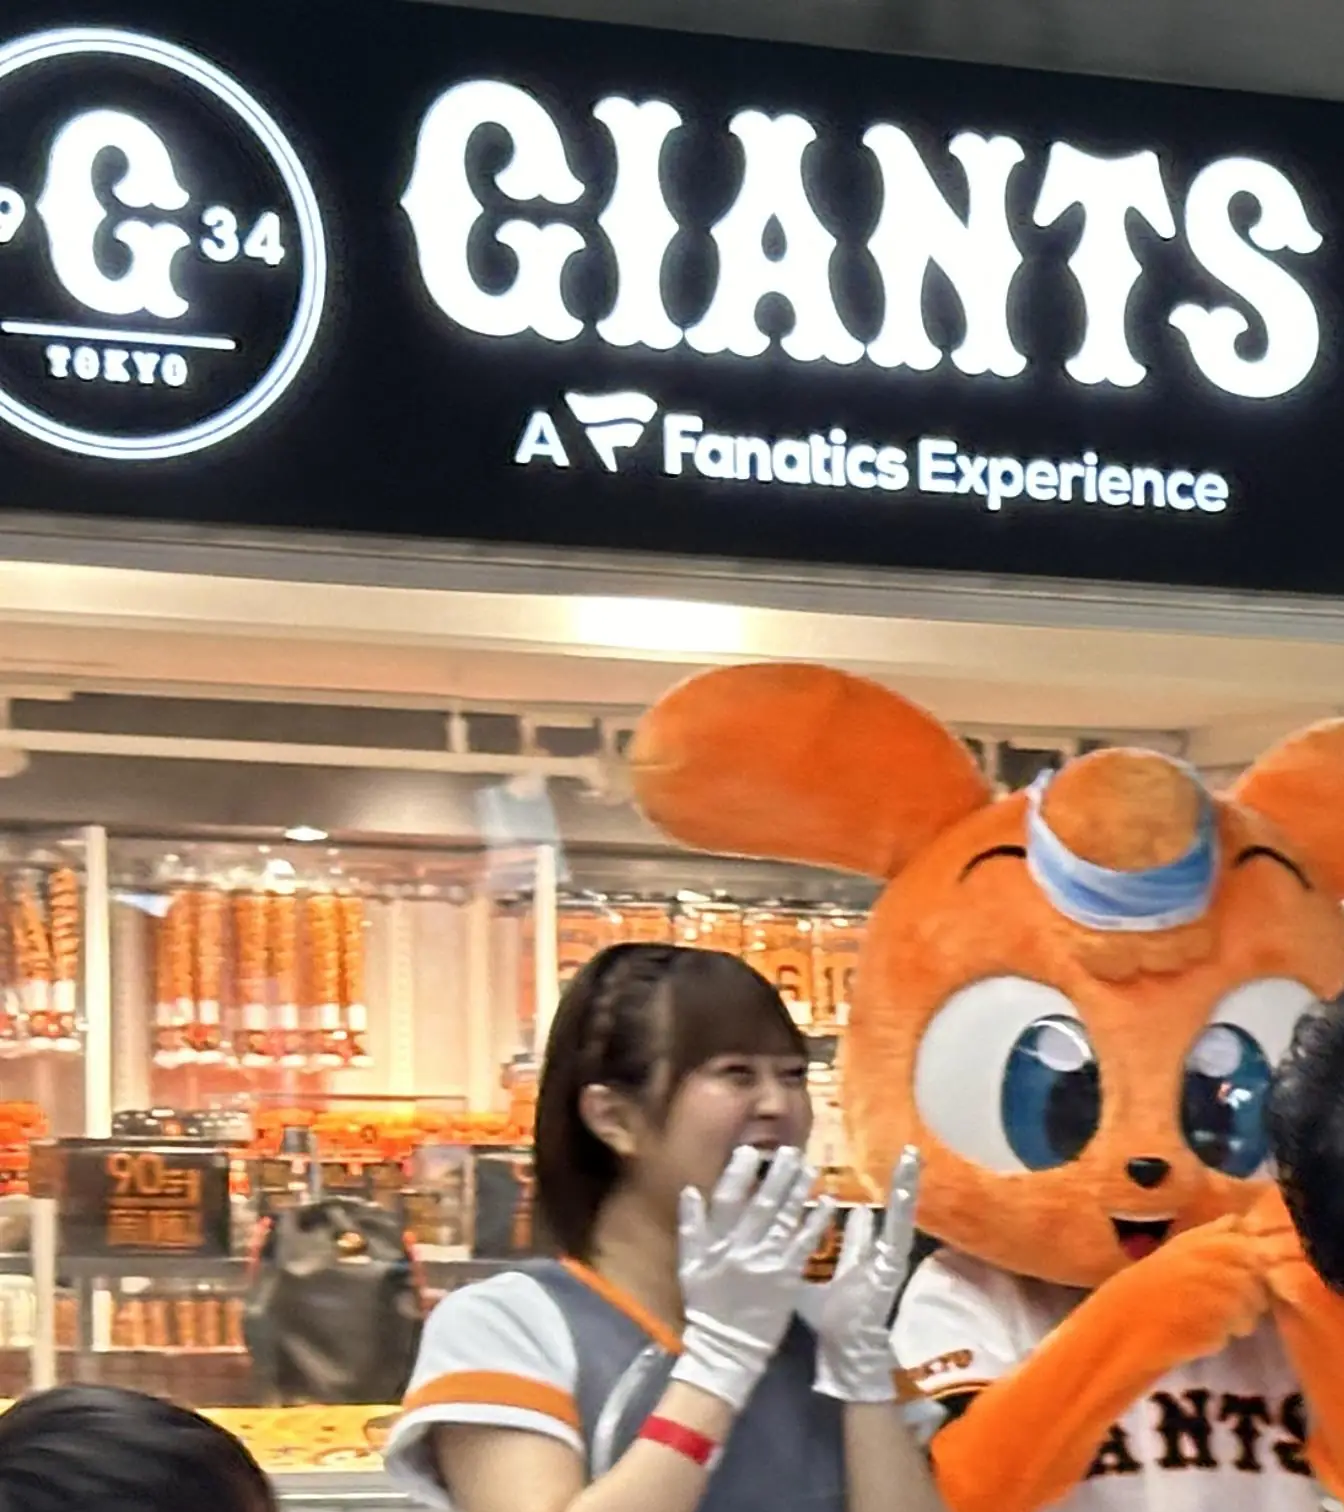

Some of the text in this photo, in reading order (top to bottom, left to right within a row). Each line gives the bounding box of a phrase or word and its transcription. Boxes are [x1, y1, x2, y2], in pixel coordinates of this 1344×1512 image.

[35, 108, 192, 320] G
[200, 204, 286, 267] 34
[399, 79, 1324, 398] GIANTS
[45, 343, 188, 388] TOKYO
[514, 410, 1230, 513] A Fanatics Experience
[1086, 1388, 1314, 1478] ANTS
